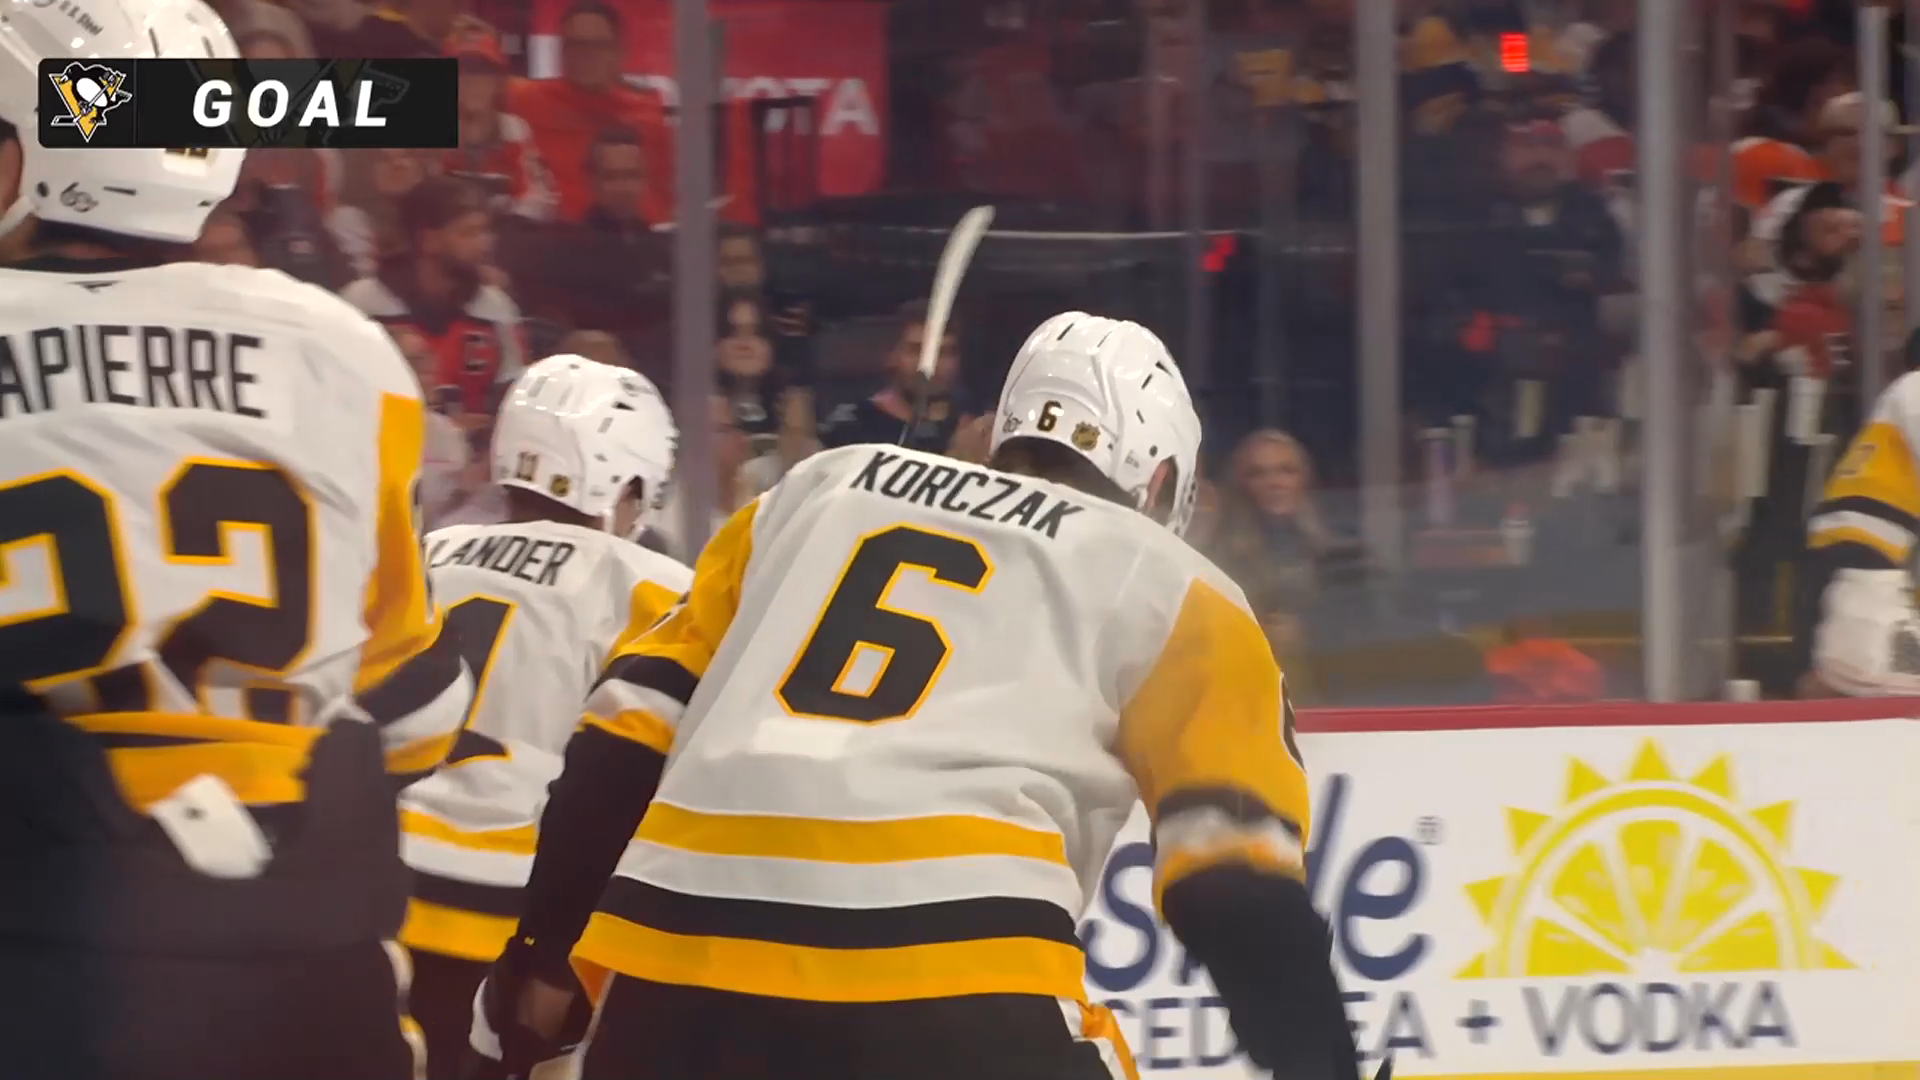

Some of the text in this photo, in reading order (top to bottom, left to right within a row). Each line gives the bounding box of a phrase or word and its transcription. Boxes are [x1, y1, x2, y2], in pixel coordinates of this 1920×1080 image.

[0, 324, 267, 419] APIERRE
[1036, 400, 1062, 432] 6
[849, 451, 1085, 539] KORCZAK
[0, 455, 320, 727] 22
[773, 521, 995, 726] 6
[1521, 981, 1798, 1057] VODKA
